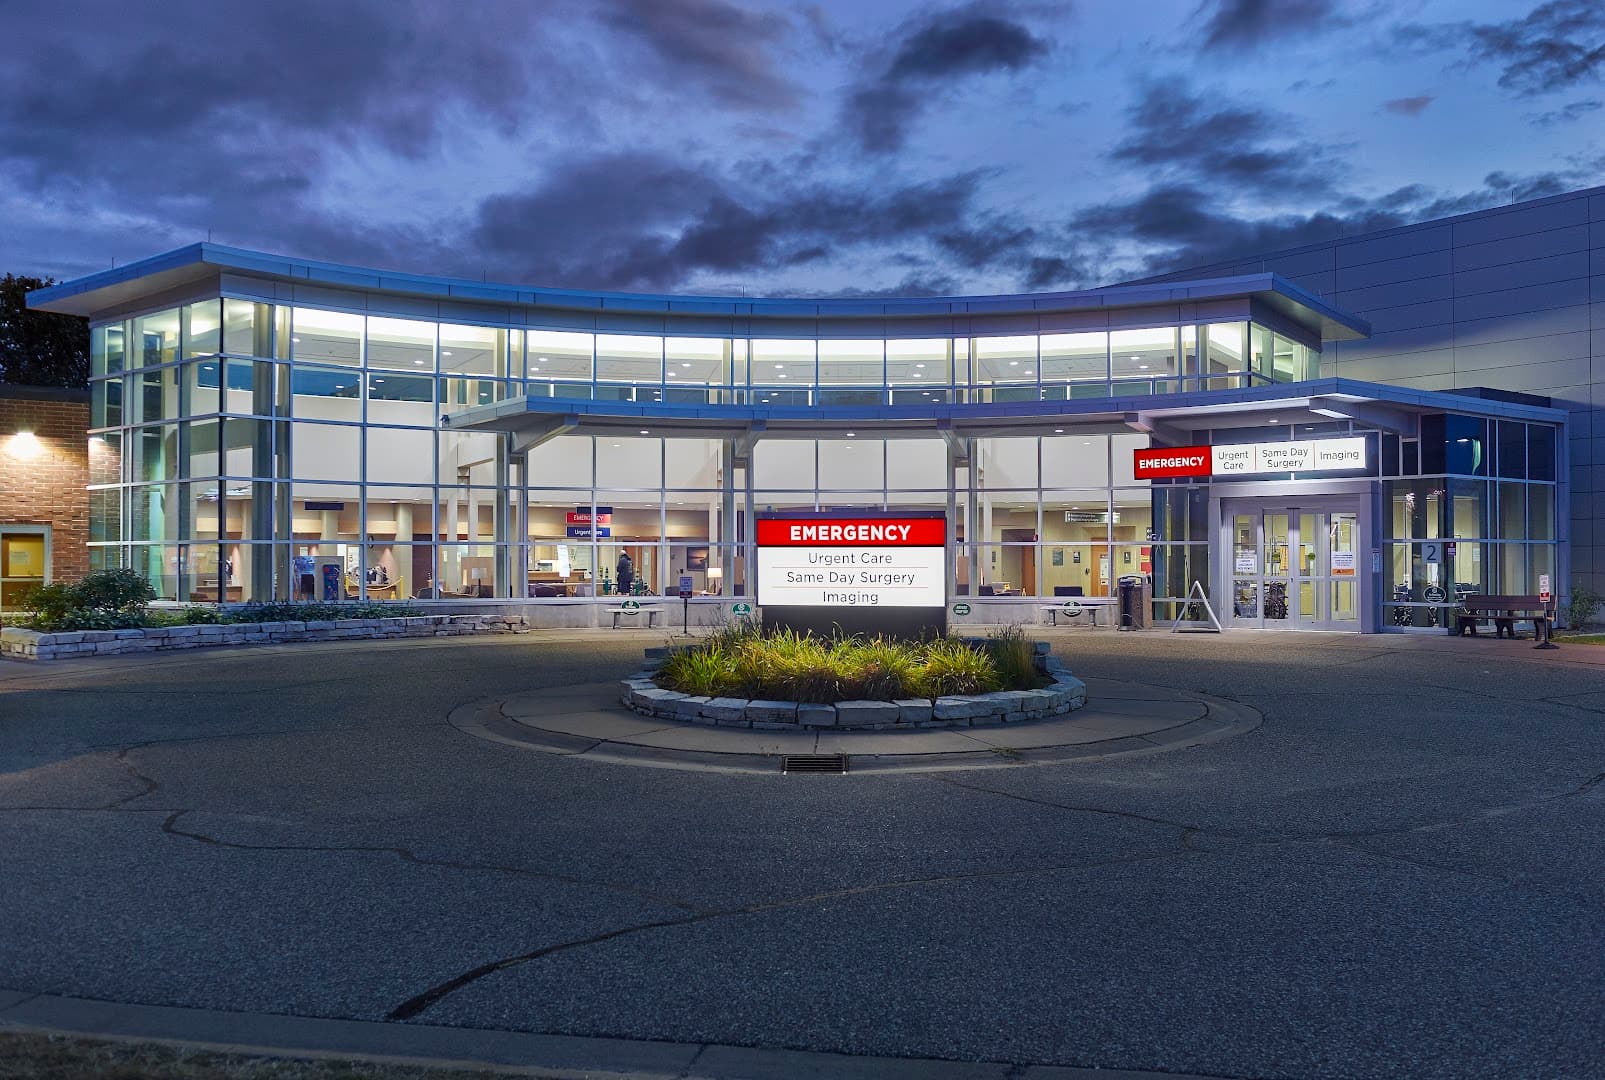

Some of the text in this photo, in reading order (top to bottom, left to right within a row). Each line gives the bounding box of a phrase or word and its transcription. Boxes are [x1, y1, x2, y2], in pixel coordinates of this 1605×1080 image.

[1218, 450, 1249, 461] Urgent
[1262, 447, 1308, 458] Same Day
[1320, 450, 1359, 461] Imaging
[1139, 456, 1204, 469] EMERGENCY
[1223, 461, 1244, 470] Care
[1267, 459, 1304, 469] Surgery
[790, 525, 911, 541] EMERGENCY
[808, 552, 893, 565] Urgent Care
[1426, 545, 1437, 561] 2
[787, 571, 915, 585] Same Day Surgery
[823, 591, 879, 605] Imaging
